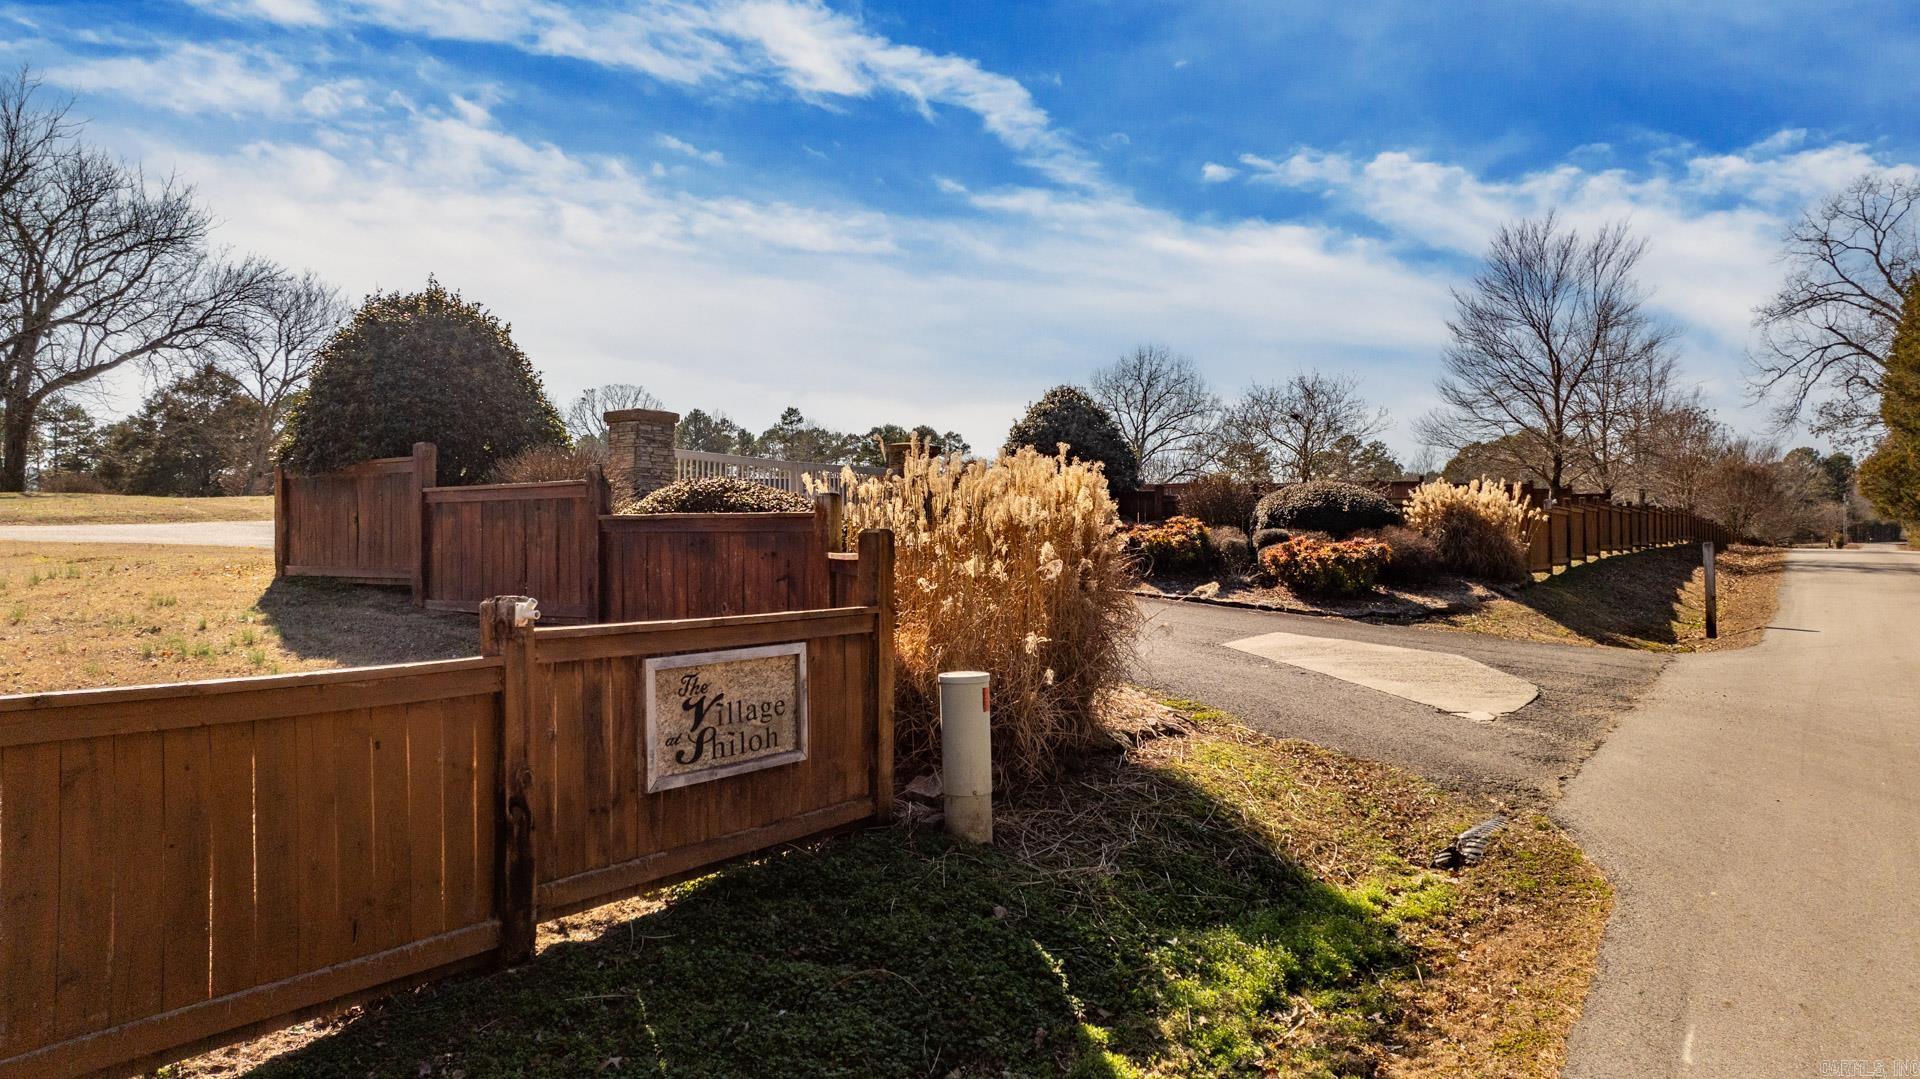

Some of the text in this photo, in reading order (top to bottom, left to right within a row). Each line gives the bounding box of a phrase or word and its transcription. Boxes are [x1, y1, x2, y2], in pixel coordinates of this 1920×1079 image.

[678, 673, 710, 698] The
[682, 693, 785, 732] Village
[665, 726, 779, 764] at Shiloh
